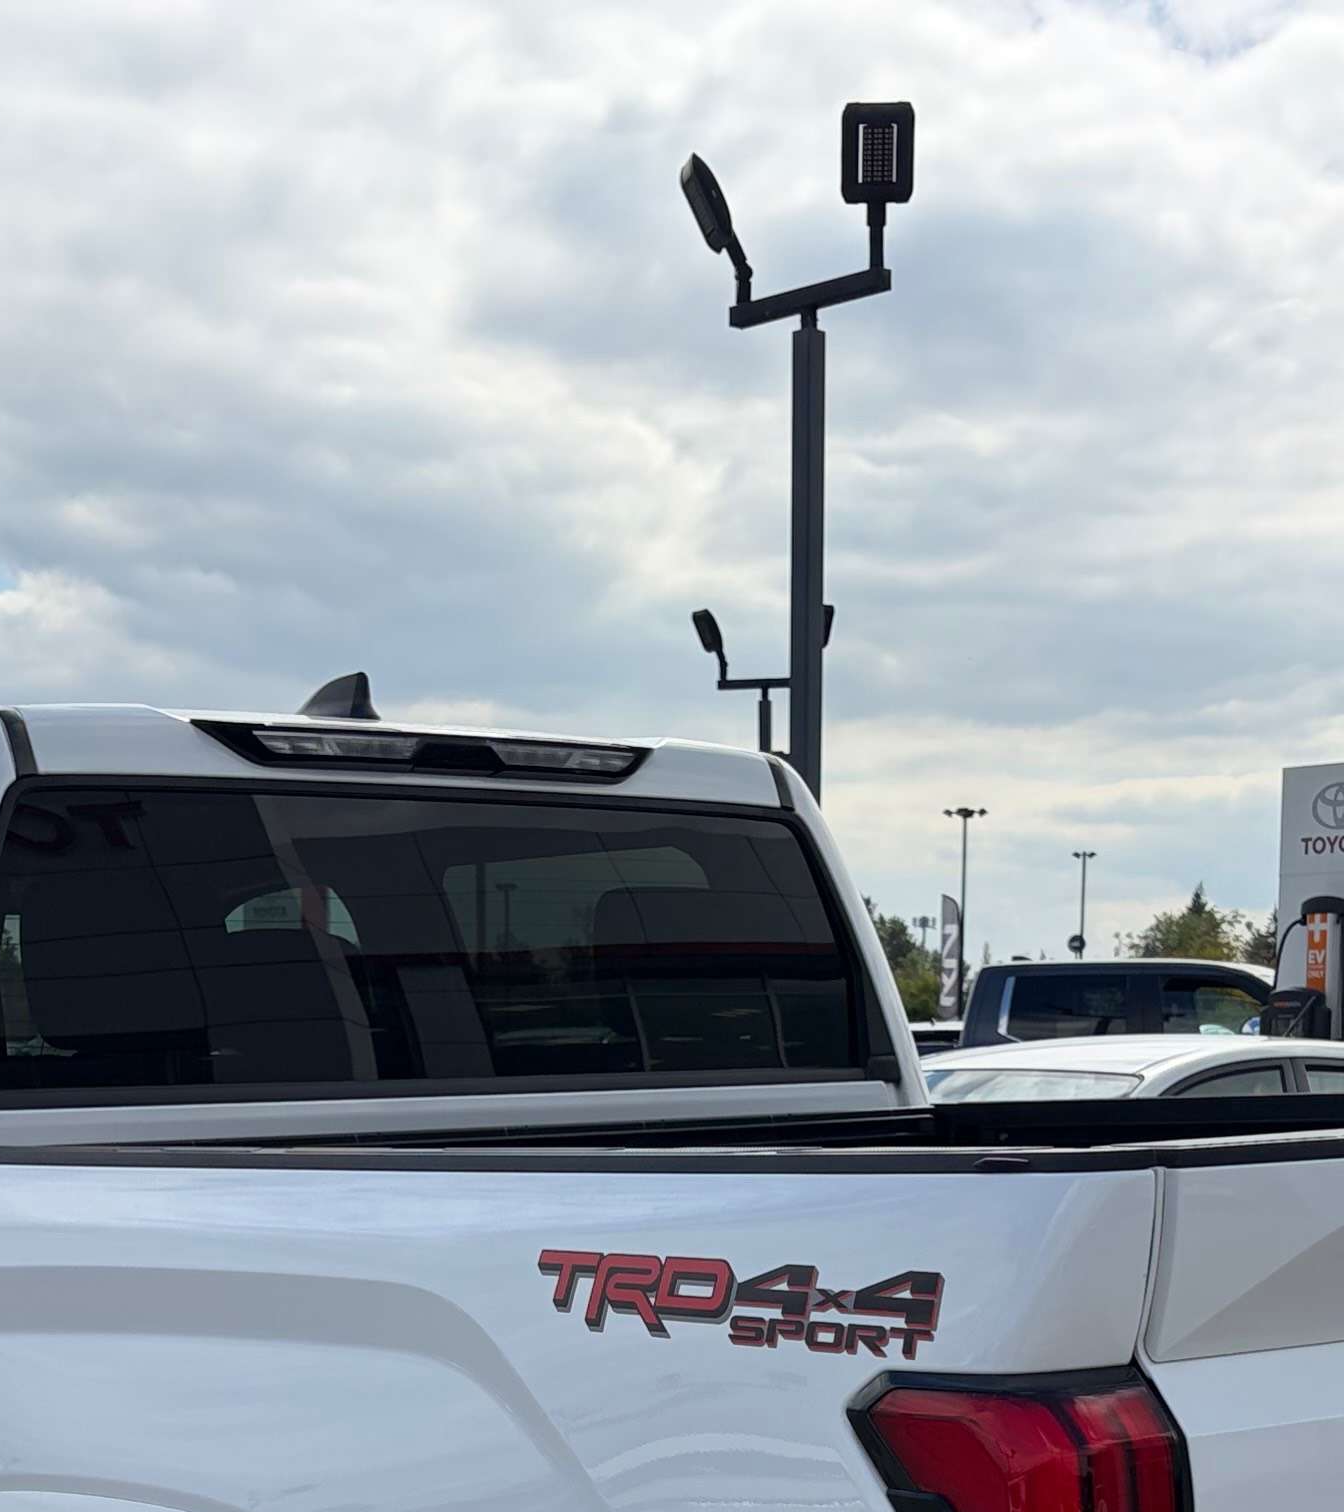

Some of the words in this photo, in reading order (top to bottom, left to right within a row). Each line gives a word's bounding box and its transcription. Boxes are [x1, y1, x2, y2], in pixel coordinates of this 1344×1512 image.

[1308, 949, 1326, 964] EV
[538, 1249, 738, 1338] TRD
[727, 1314, 935, 1360] SPORT
